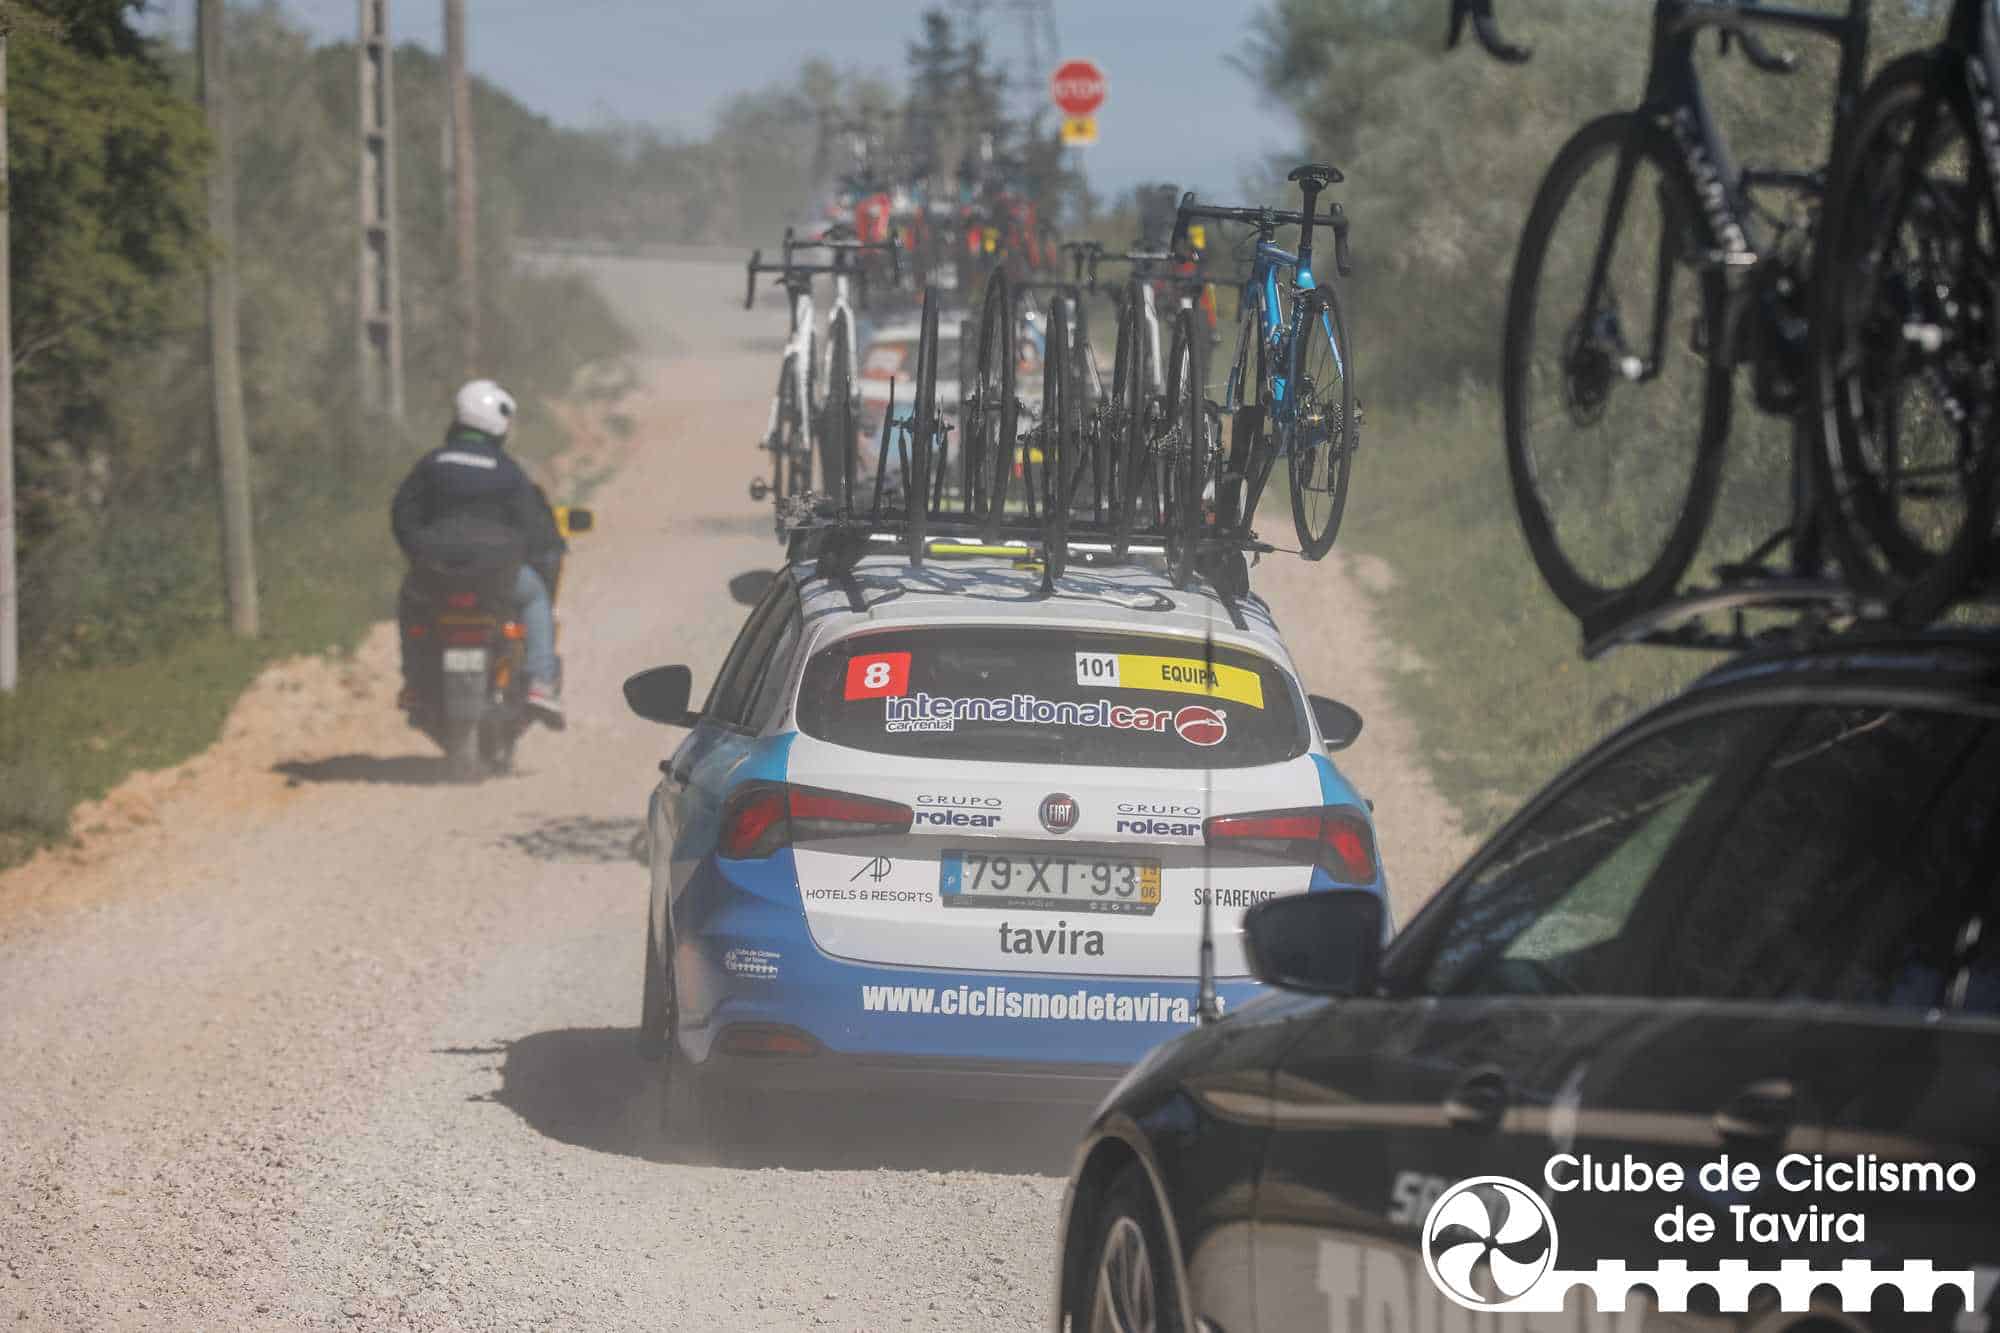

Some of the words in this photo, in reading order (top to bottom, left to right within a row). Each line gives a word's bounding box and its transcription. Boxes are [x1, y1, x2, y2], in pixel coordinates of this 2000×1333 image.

[864, 662, 891, 689] 8
[1079, 658, 1115, 678] 101
[1161, 664, 1220, 688] EQUIPA
[885, 693, 1173, 732] internationalcar
[916, 794, 1002, 807] GRUPO
[1117, 803, 1202, 816] GRUPO
[913, 810, 1001, 828] rolear
[1049, 803, 1072, 825] FIAT
[1116, 820, 1201, 836] rolear
[806, 889, 857, 901] HOTELS
[859, 890, 869, 901] &
[871, 891, 934, 903] RESORTS
[999, 921, 1104, 956] tavira
[862, 985, 1225, 1028] www.ciclismodetavira.t
